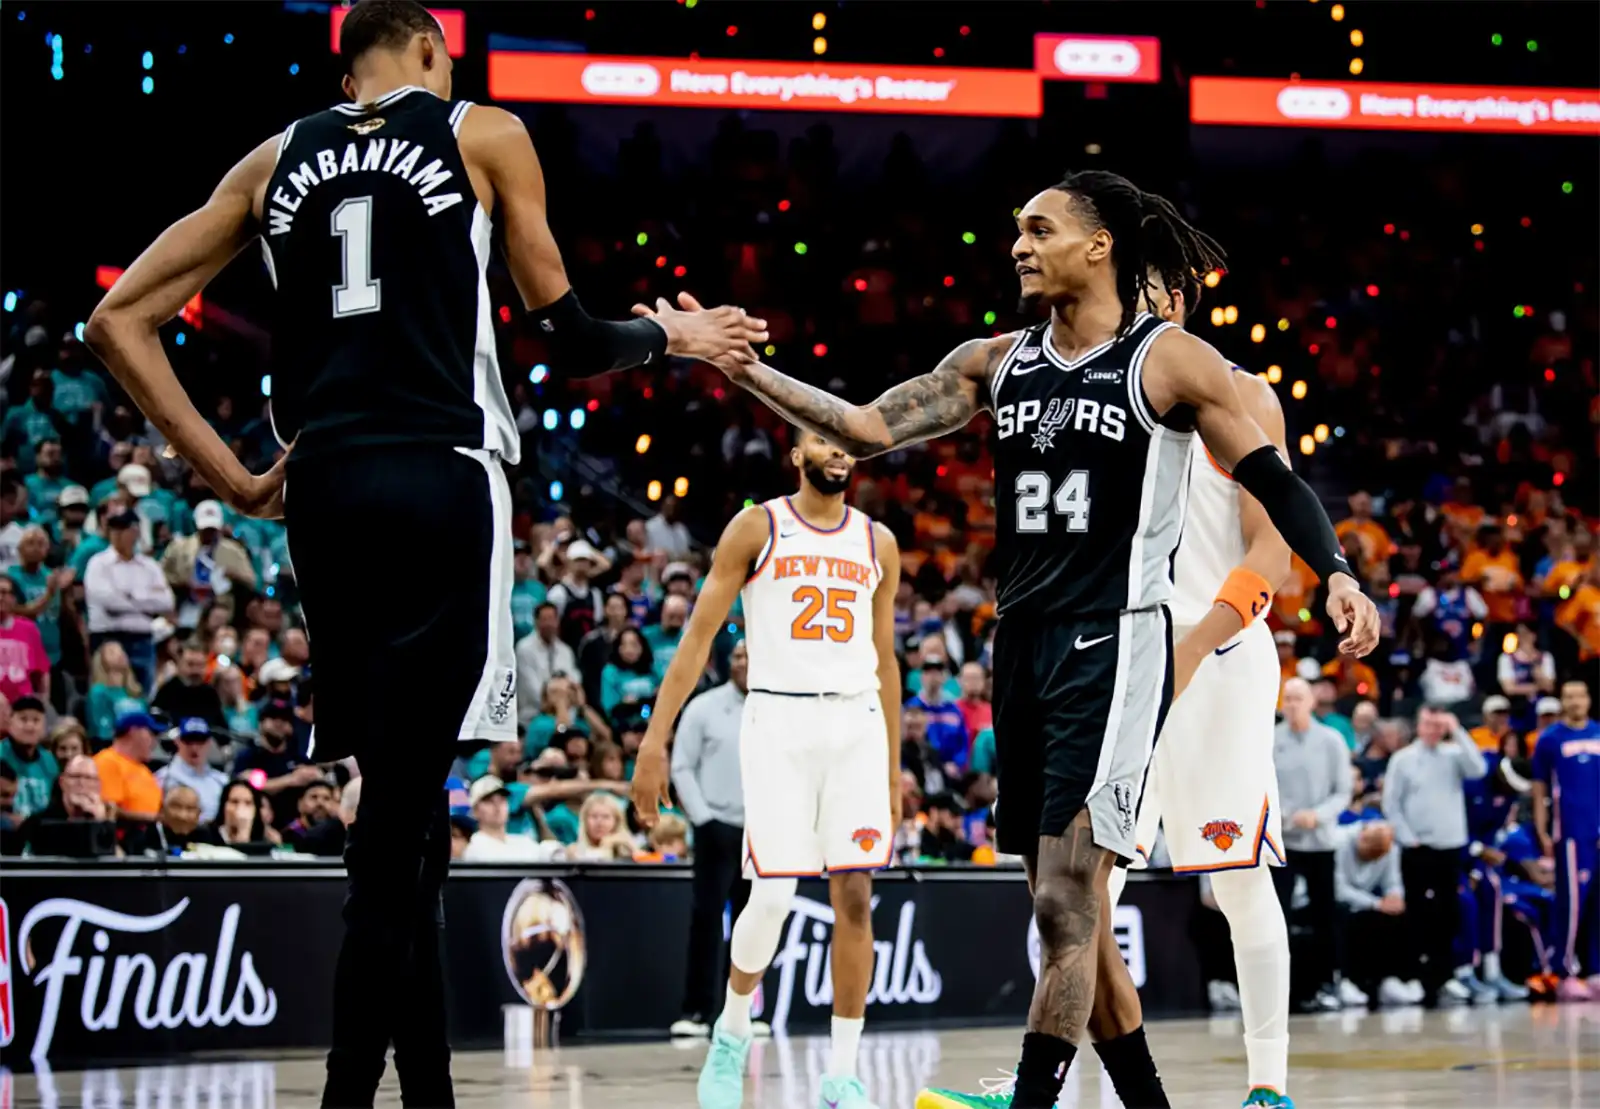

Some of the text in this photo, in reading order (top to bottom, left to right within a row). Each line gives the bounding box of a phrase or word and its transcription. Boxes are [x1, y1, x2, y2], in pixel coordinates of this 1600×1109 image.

[269, 138, 463, 235] WEMBANYAMA
[330, 195, 381, 318] 1
[997, 398, 1127, 453] SPURS
[1014, 469, 1091, 533] 24
[773, 555, 872, 589] NEW YORK
[791, 585, 857, 643] 25
[17, 896, 278, 1057] Finals
